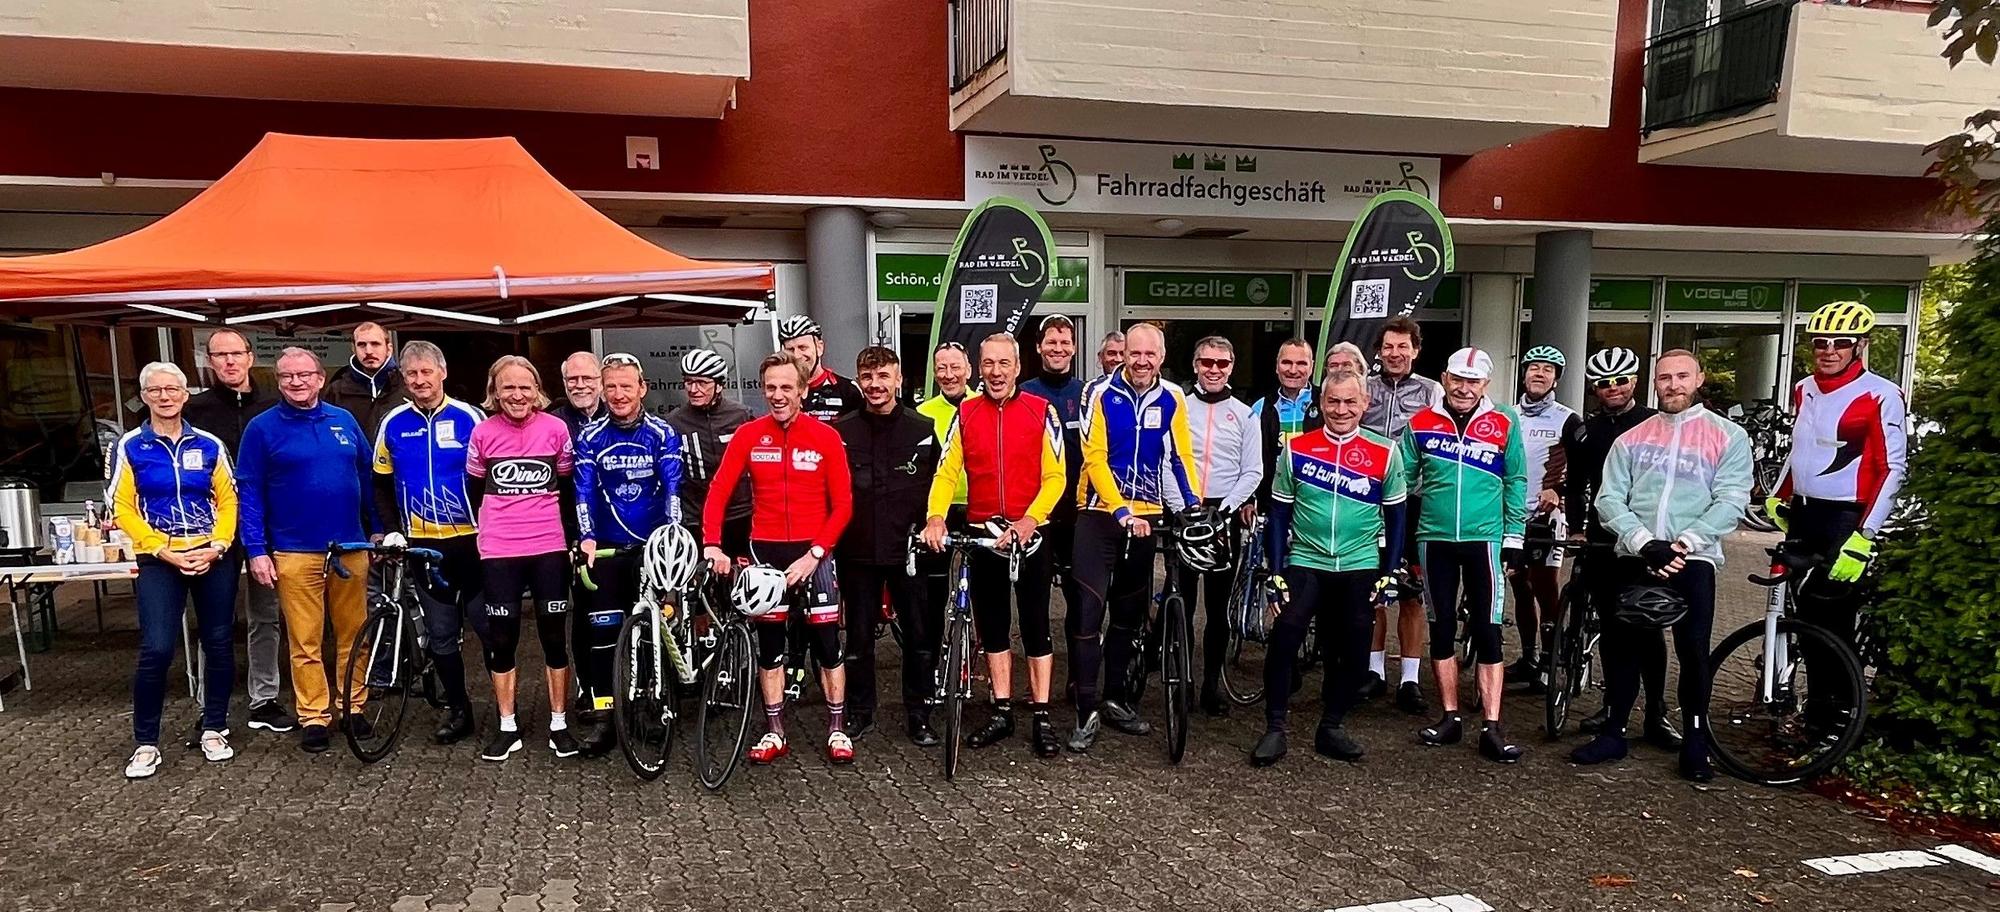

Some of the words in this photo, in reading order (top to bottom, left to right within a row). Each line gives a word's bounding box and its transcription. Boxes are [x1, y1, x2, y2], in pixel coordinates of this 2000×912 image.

[975, 170, 995, 179] RAD
[997, 171, 1010, 180] IM
[1012, 172, 1050, 181] VEEDEL
[1096, 173, 1327, 206] Fahrradfachgeschäft
[1343, 185, 1360, 193] RAD
[959, 260, 975, 269] RAD
[976, 260, 989, 268] IM
[989, 260, 1021, 268] VEEDEL
[1351, 257, 1368, 265] RAD
[885, 272, 930, 287] Schön,
[1149, 279, 1236, 298] Gazelle
[1682, 288, 1748, 300] VOGUE
[619, 455, 654, 464] TITAN
[497, 462, 548, 482] Dino's
